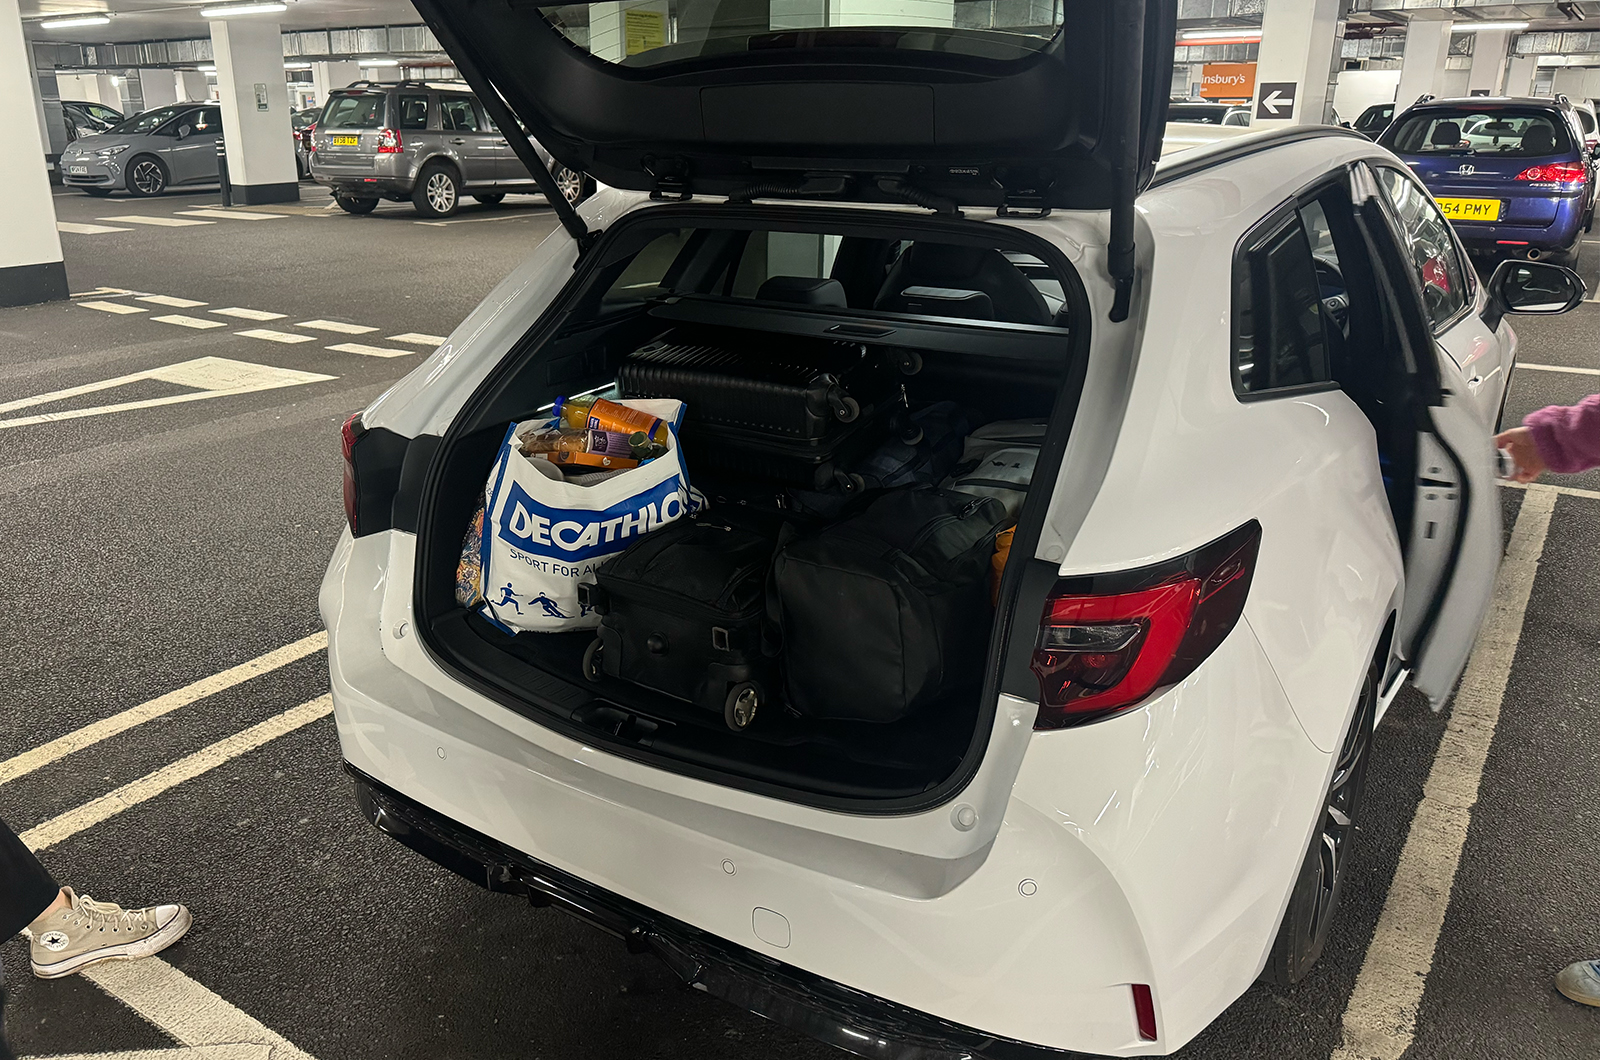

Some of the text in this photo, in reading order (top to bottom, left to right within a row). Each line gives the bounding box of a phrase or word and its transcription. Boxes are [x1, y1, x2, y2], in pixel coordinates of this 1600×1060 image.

[1202, 73, 1246, 86] insbury's
[1464, 203, 1492, 216] PMY
[509, 547, 549, 573] SPORT
[552, 563, 580, 578] FOR
